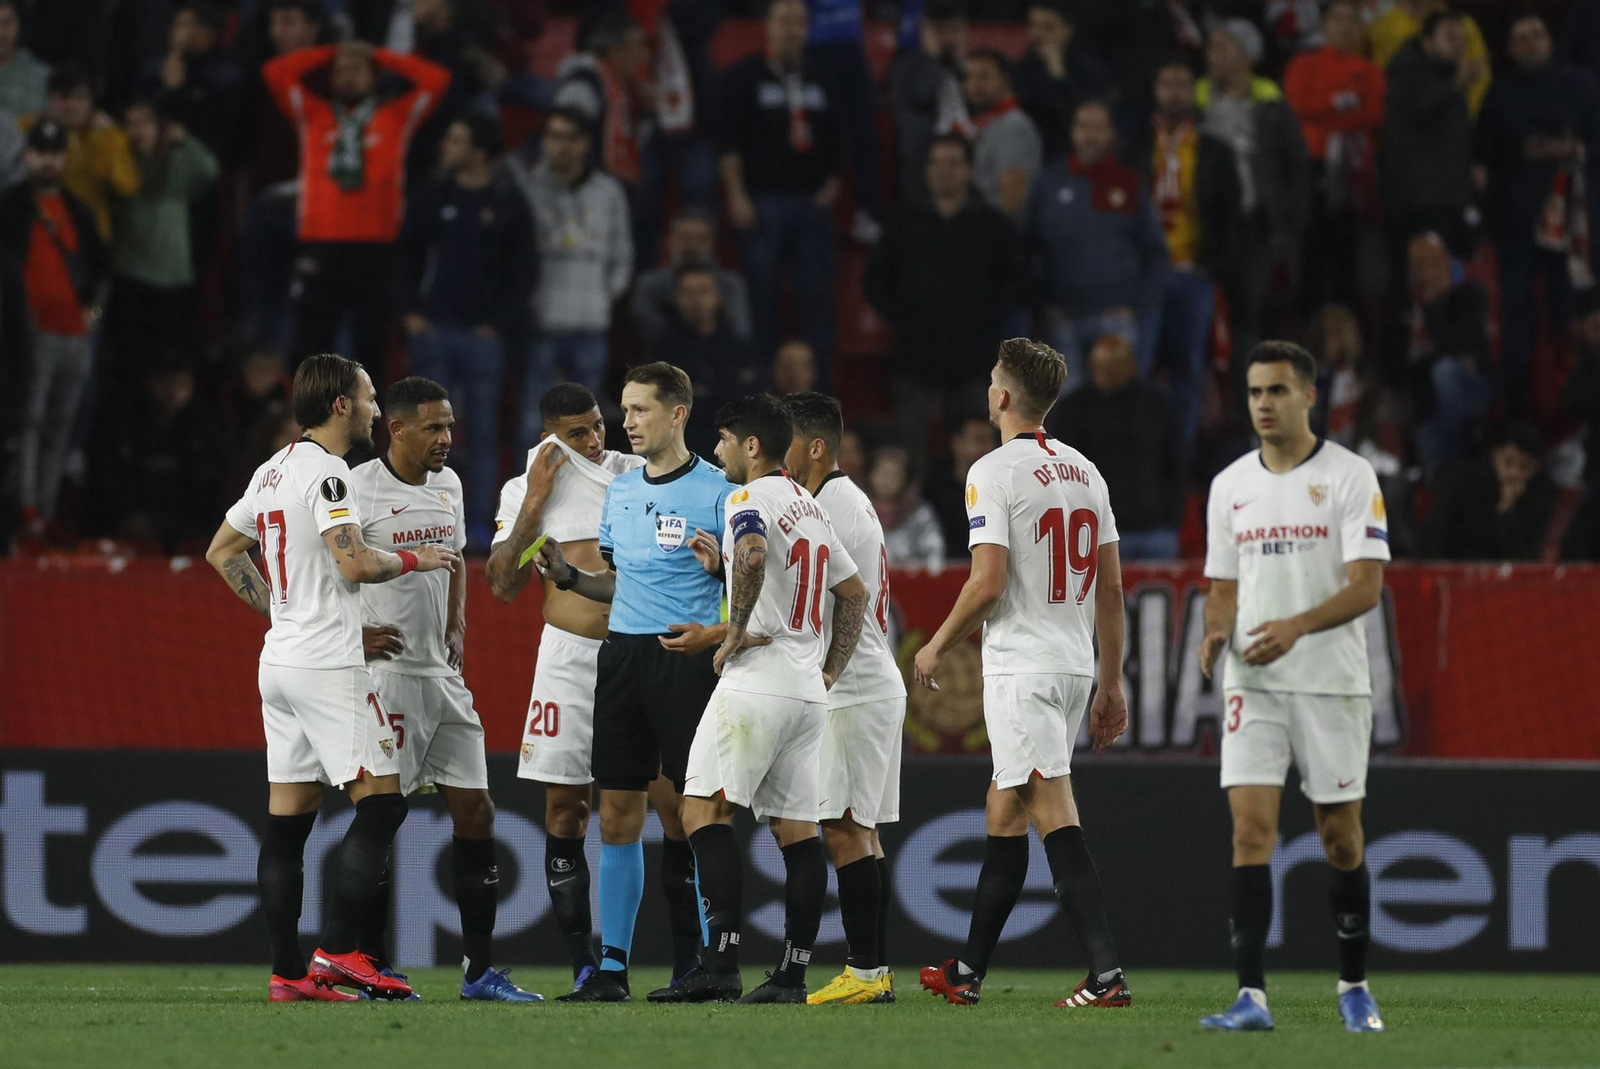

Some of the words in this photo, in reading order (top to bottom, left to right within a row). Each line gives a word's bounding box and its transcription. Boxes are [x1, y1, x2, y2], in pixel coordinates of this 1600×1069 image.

[1033, 463, 1056, 488] DE
[1052, 462, 1090, 488] JONG
[657, 532, 682, 540] REFEREE
[1236, 525, 1329, 544] MARATHON
[1262, 541, 1294, 555] BET
[256, 509, 288, 605] 17
[1034, 507, 1099, 606] 19
[785, 537, 830, 639] 10
[528, 699, 562, 738] 20
[1227, 695, 1245, 733] 3
